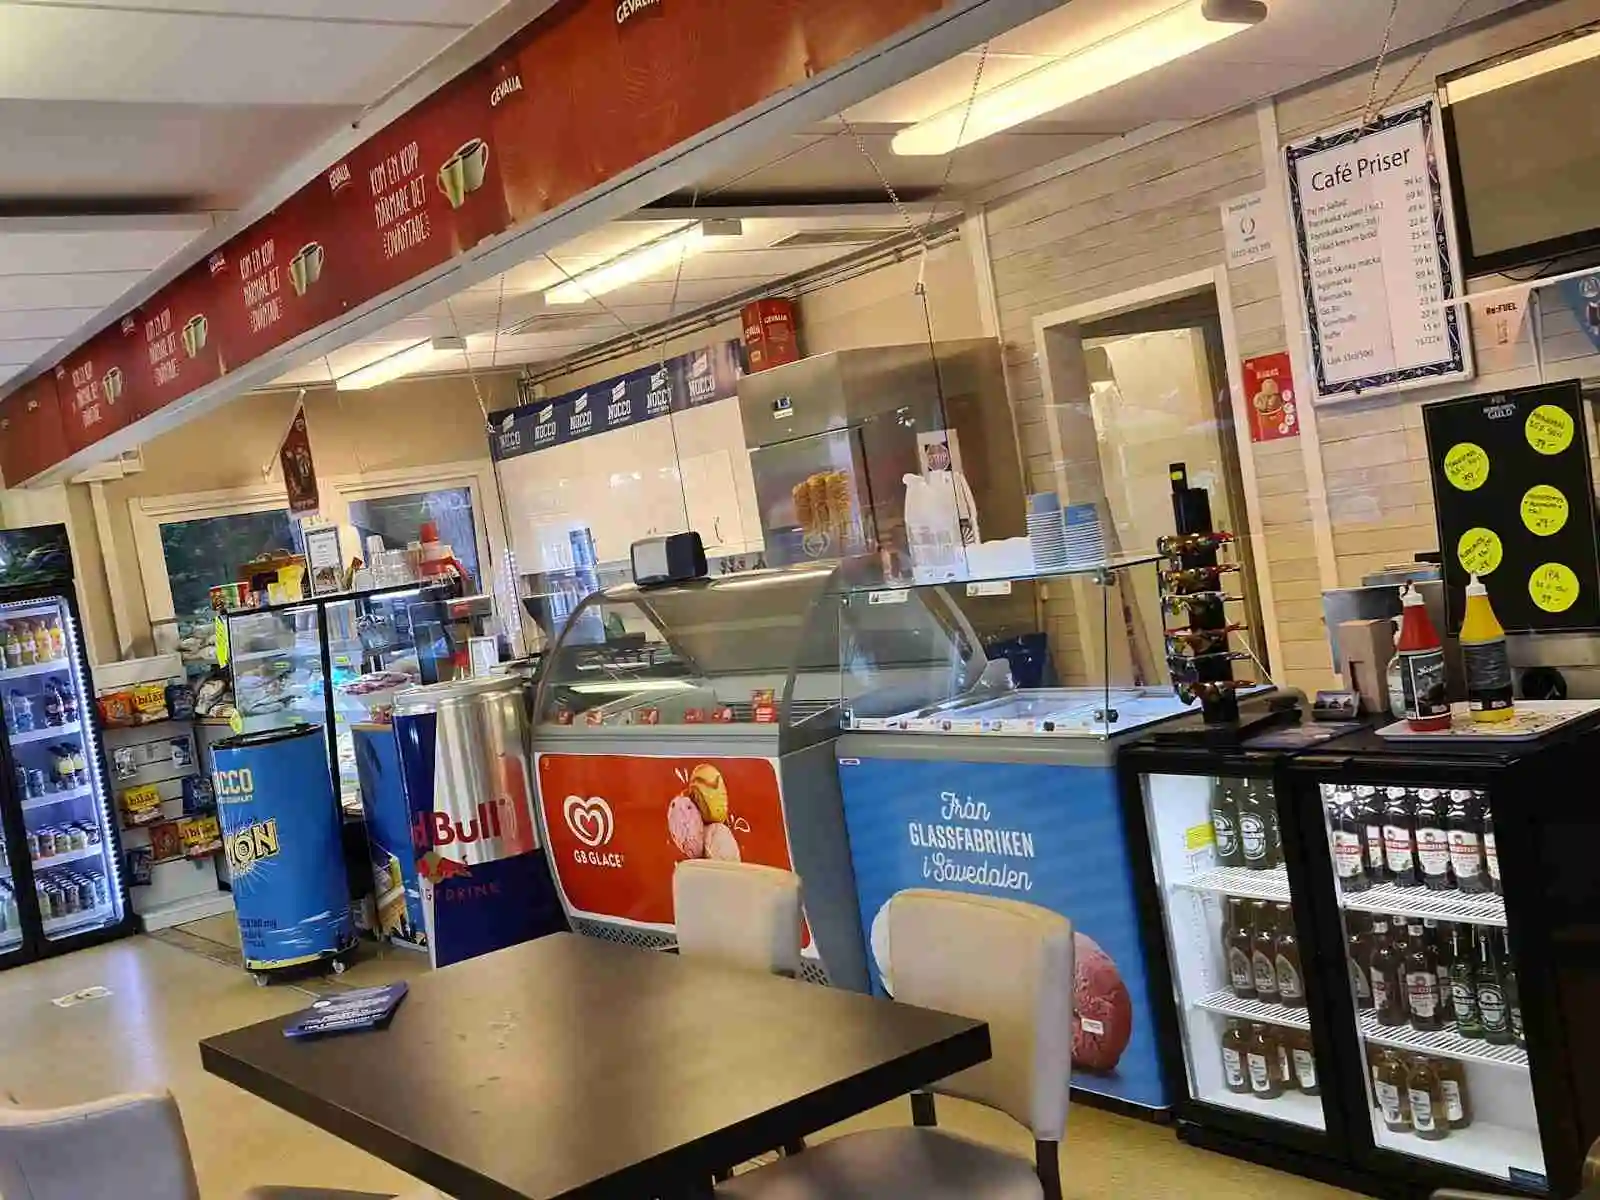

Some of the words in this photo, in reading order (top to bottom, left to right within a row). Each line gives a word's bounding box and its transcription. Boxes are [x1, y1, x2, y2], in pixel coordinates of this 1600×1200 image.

[616, 0, 660, 23] GEVAL
[490, 76, 522, 106] GEVALIA
[399, 141, 419, 177] KOPP
[1311, 162, 1353, 192] Café
[1357, 148, 1410, 178] Priser
[410, 174, 426, 209] DET
[688, 376, 716, 397] NOCCO
[569, 411, 592, 430] NOCCO
[607, 399, 632, 420] NOCCO
[1487, 409, 1513, 420] GULD
[534, 422, 557, 440] NOCCO
[138, 688, 165, 706] bilar
[129, 792, 156, 807] bilar
[940, 791, 991, 821] Från
[433, 800, 502, 846] Bull
[908, 821, 1036, 858] GLASSFABRIKEN
[574, 849, 588, 864] GB
